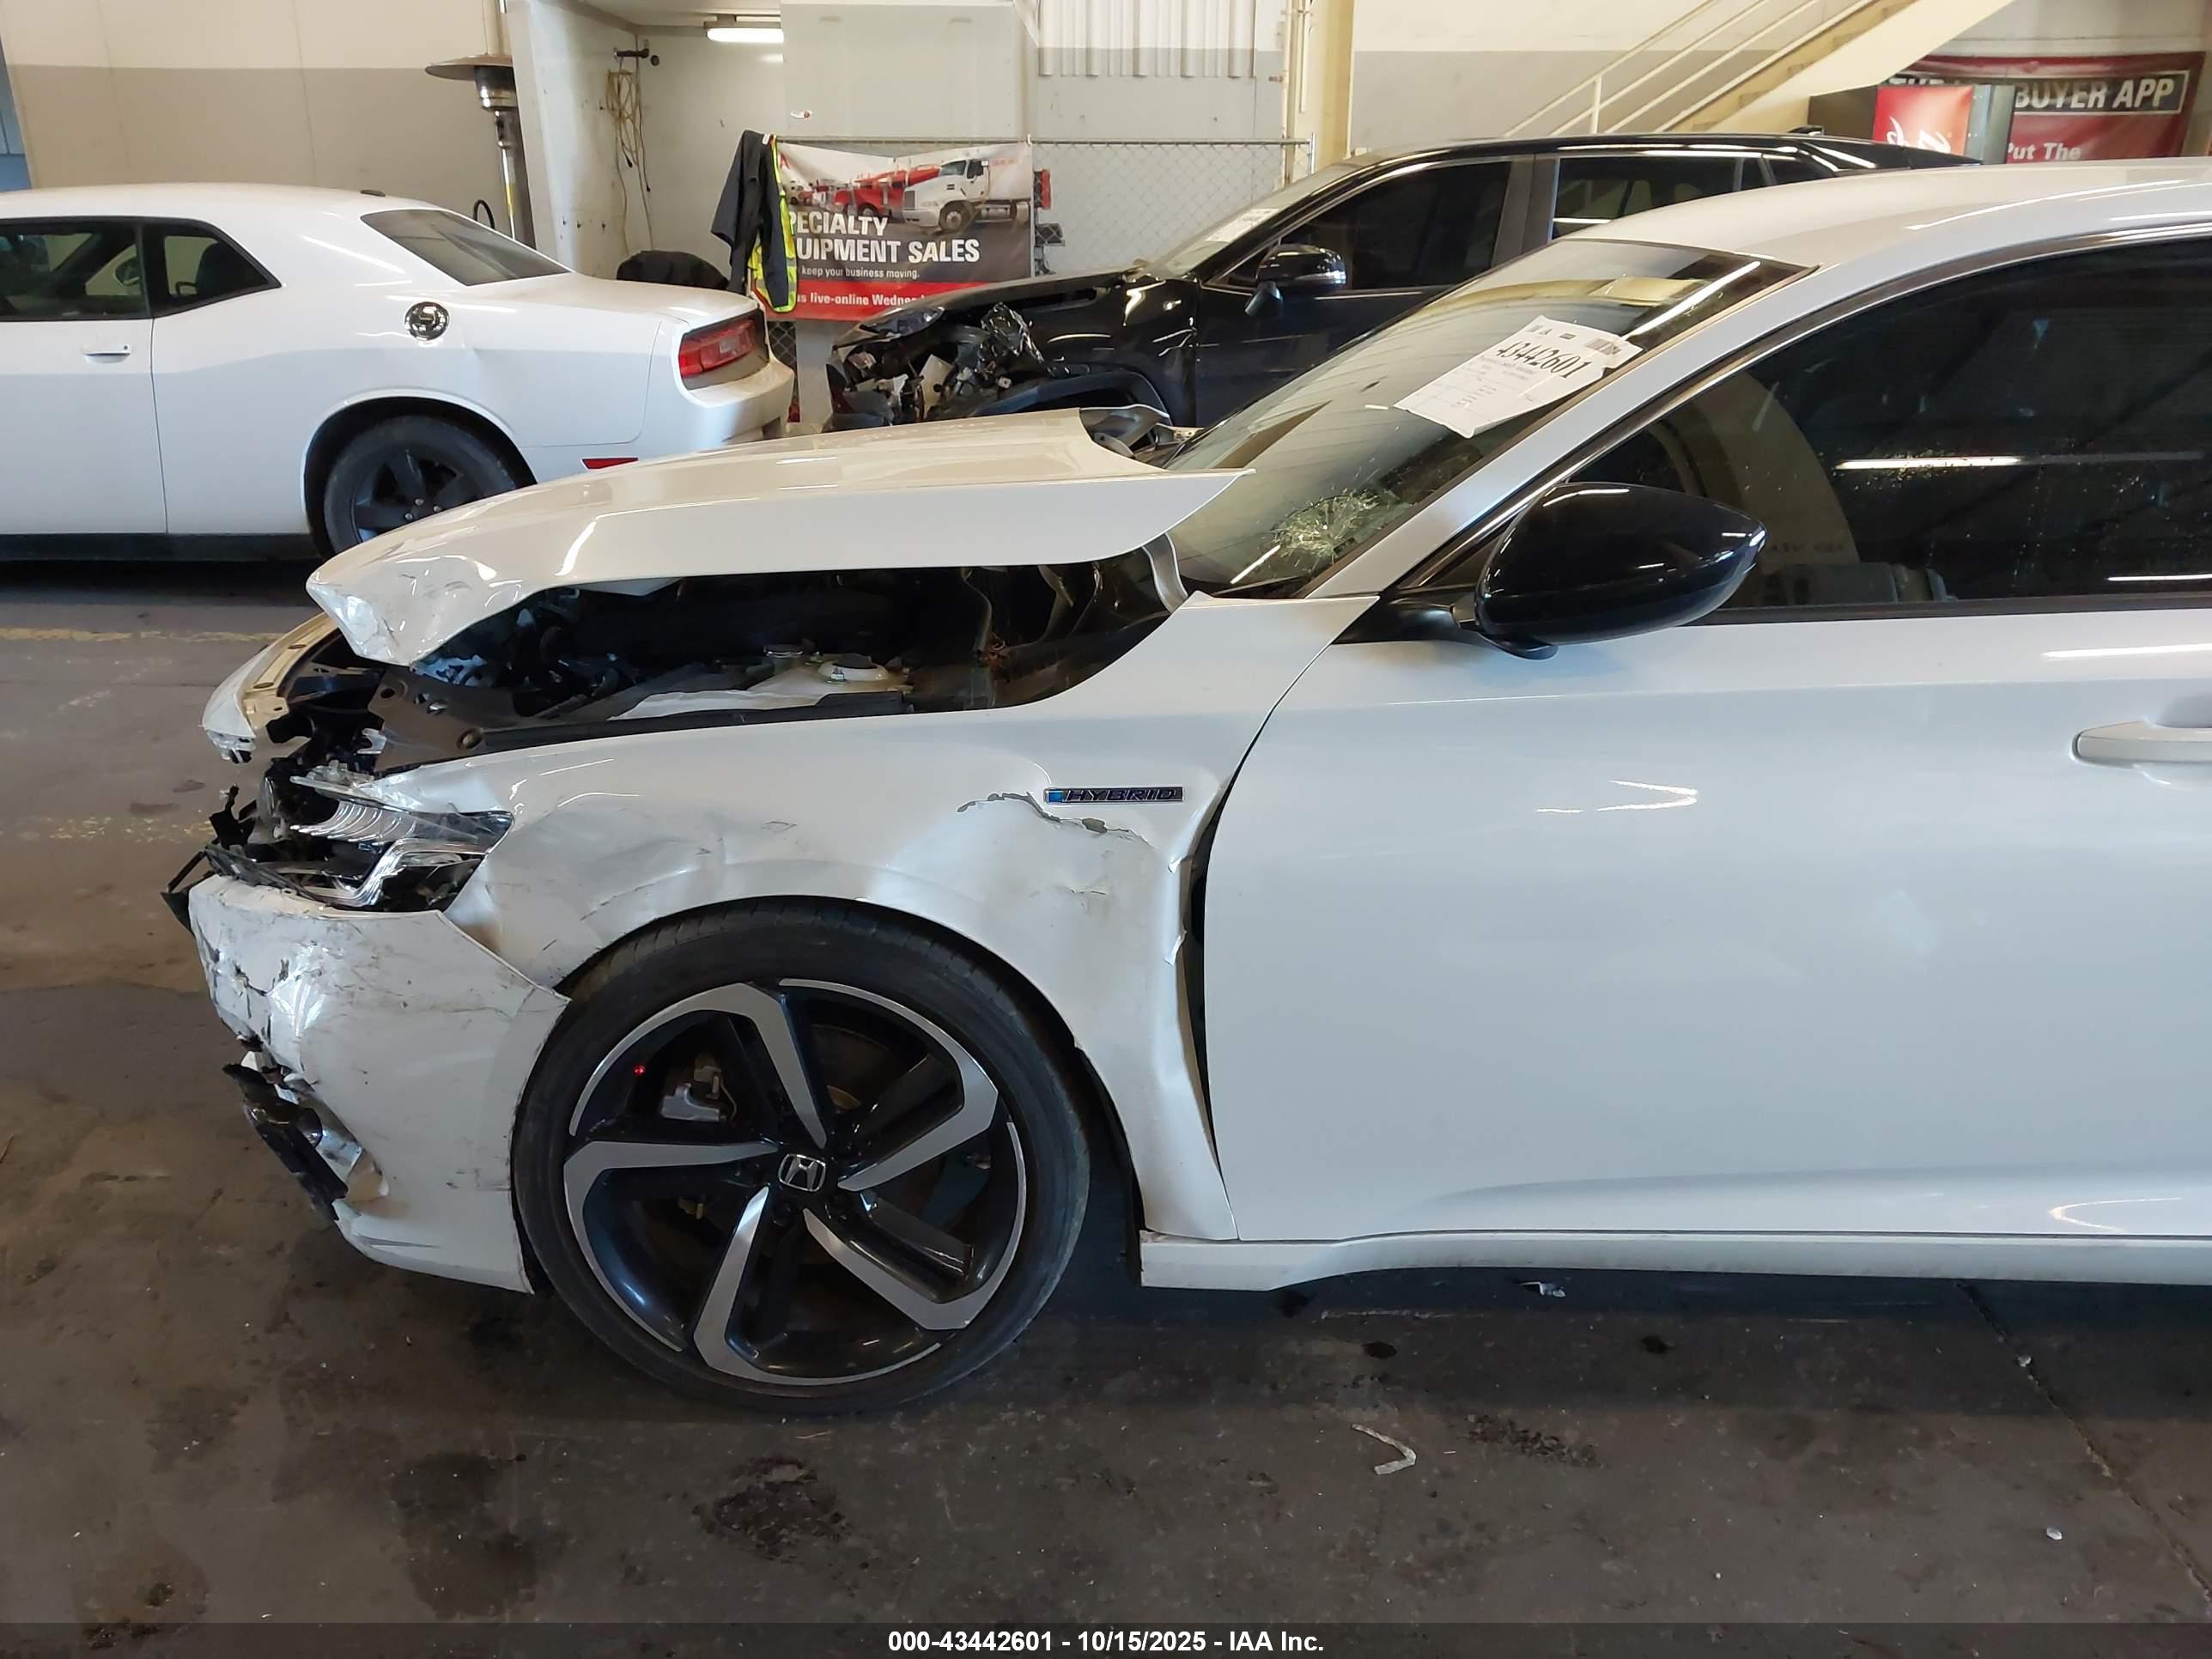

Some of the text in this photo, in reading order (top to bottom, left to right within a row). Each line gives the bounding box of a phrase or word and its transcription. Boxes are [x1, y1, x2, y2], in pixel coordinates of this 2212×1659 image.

[2015, 79, 2174, 109] BUYER APP
[2044, 143, 2081, 161] The
[789, 211, 888, 236] PECIALTY
[797, 238, 980, 263] UIPMENT SALES
[802, 265, 920, 280] keep your business moving.
[811, 293, 869, 306] live-online
[1496, 341, 1592, 378] 43442601
[1062, 788, 1177, 802] HYBRID
